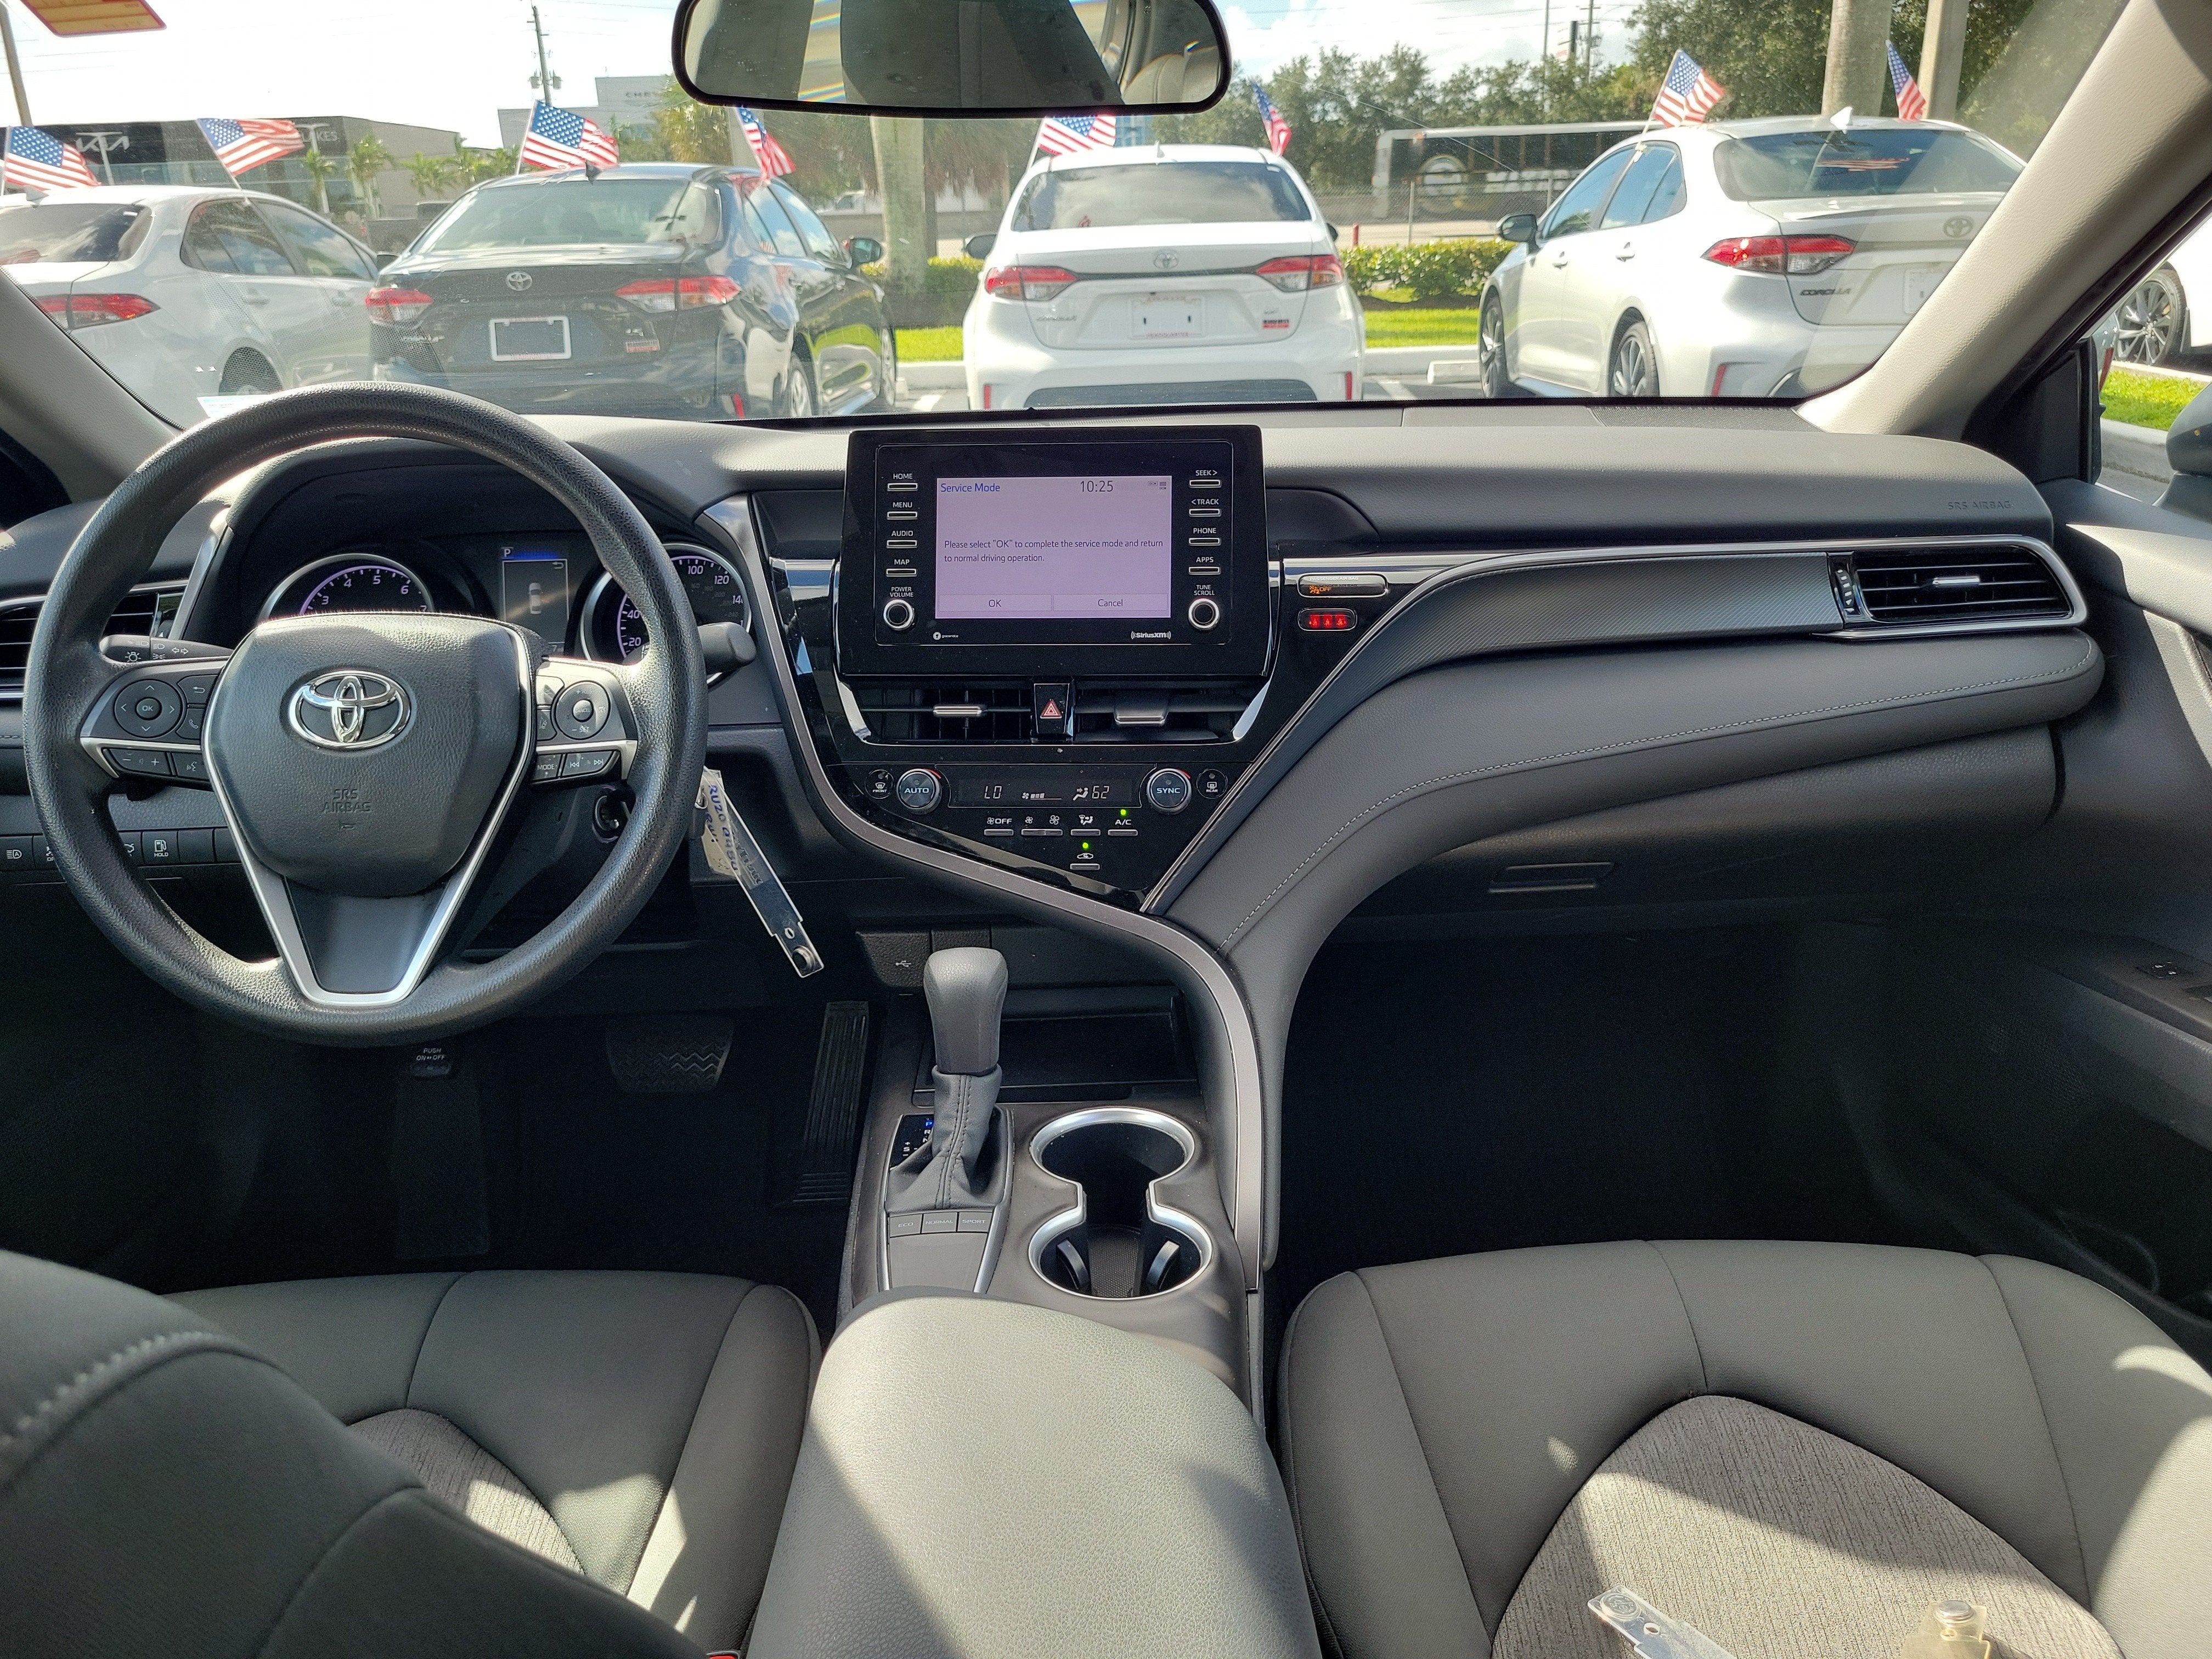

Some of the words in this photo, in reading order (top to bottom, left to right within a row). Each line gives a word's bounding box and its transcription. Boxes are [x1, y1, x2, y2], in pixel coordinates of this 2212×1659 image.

[76, 136, 130, 153] KA
[940, 483, 972, 492] Service
[974, 483, 1001, 492] Mode
[1080, 480, 1114, 493] 10:25
[1948, 501, 1968, 510] SRS
[1972, 501, 2011, 510] AIRBAG
[992, 539, 1013, 548] "OK"
[1024, 540, 1059, 550] complete
[504, 549, 511, 557] P
[980, 554, 1006, 563] driving
[1007, 554, 1045, 563] operation.
[687, 566, 704, 575] 100
[343, 578, 352, 588] 4
[373, 575, 381, 585] 5
[714, 575, 730, 585] 120
[400, 585, 409, 595] 6
[321, 596, 329, 605] 3
[988, 599, 1002, 607] OK
[1097, 599, 1124, 607] Cancel
[627, 610, 640, 619] 40
[629, 637, 641, 647] 20
[333, 788, 358, 800] SRS
[1092, 786, 1110, 799] 62
[320, 801, 372, 813] AIRBAG
